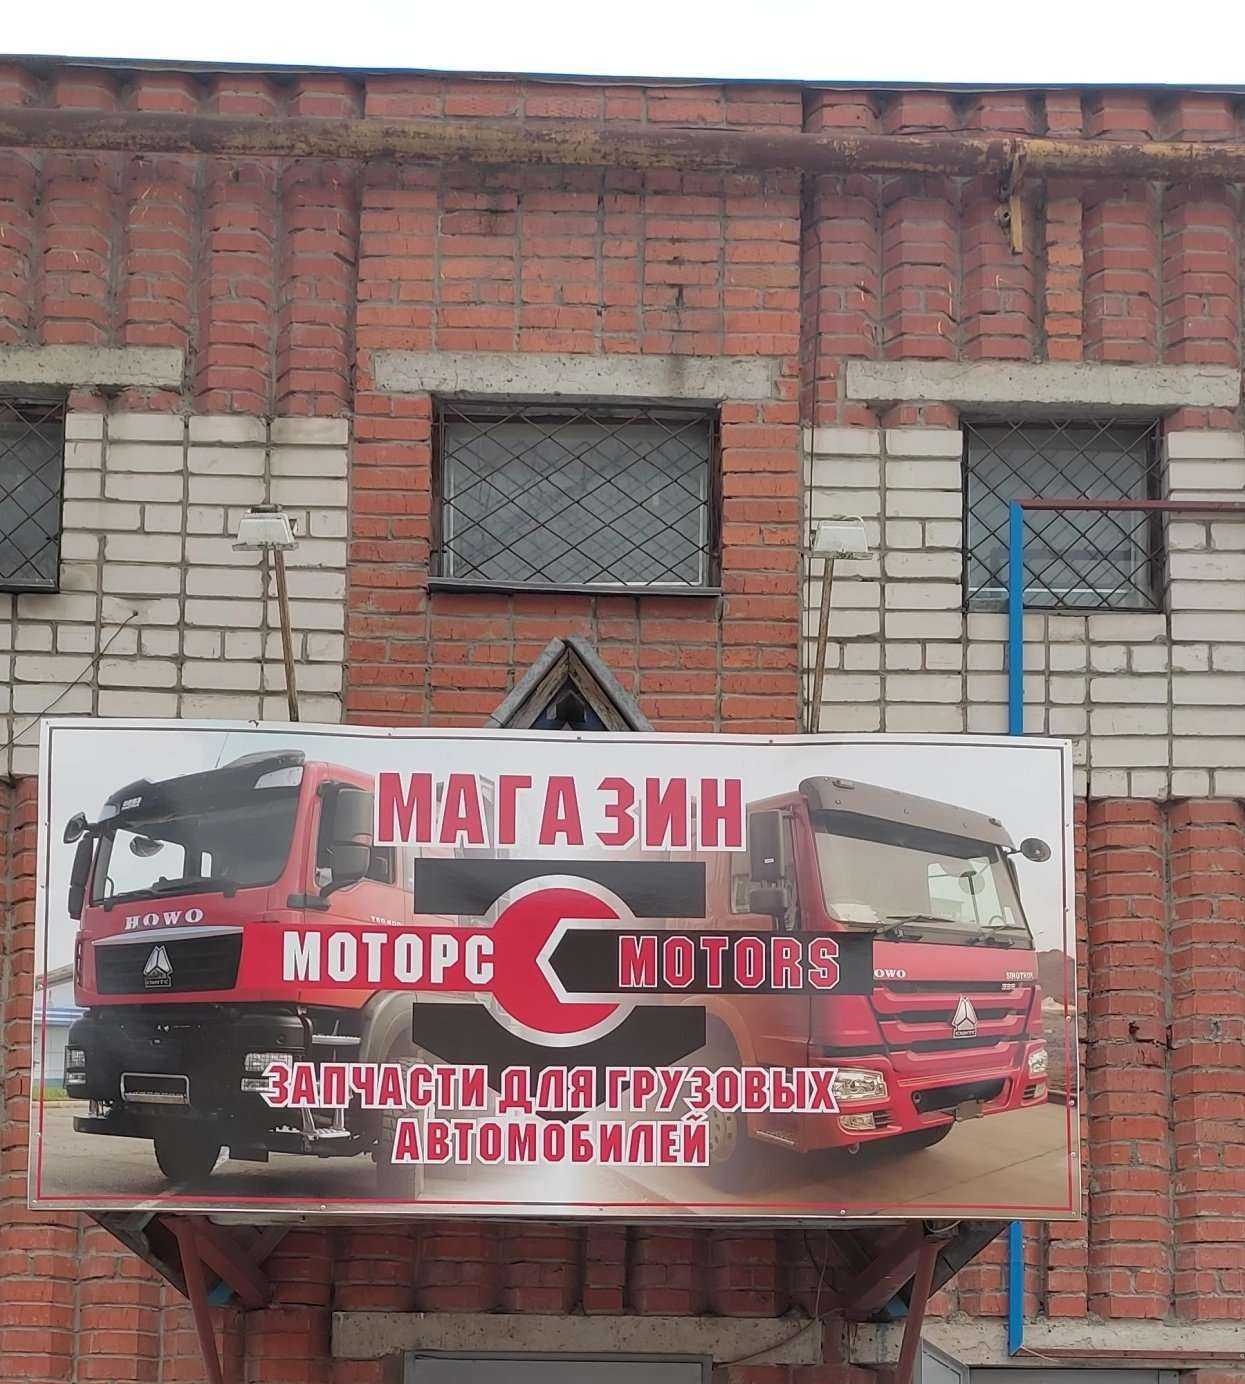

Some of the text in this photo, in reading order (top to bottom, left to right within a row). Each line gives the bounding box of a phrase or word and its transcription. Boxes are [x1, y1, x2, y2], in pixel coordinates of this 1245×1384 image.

[375, 771, 746, 851] МАГАЗИН
[124, 908, 204, 931] HOWO
[282, 930, 495, 985] МОТОРС
[617, 935, 840, 990] MOTORS
[261, 1062, 840, 1116] ЗАПЧАСТИ ДЛЯ ГРУЗОВЫХ
[391, 1110, 710, 1167] АВТОМОБИЛЕЙ
